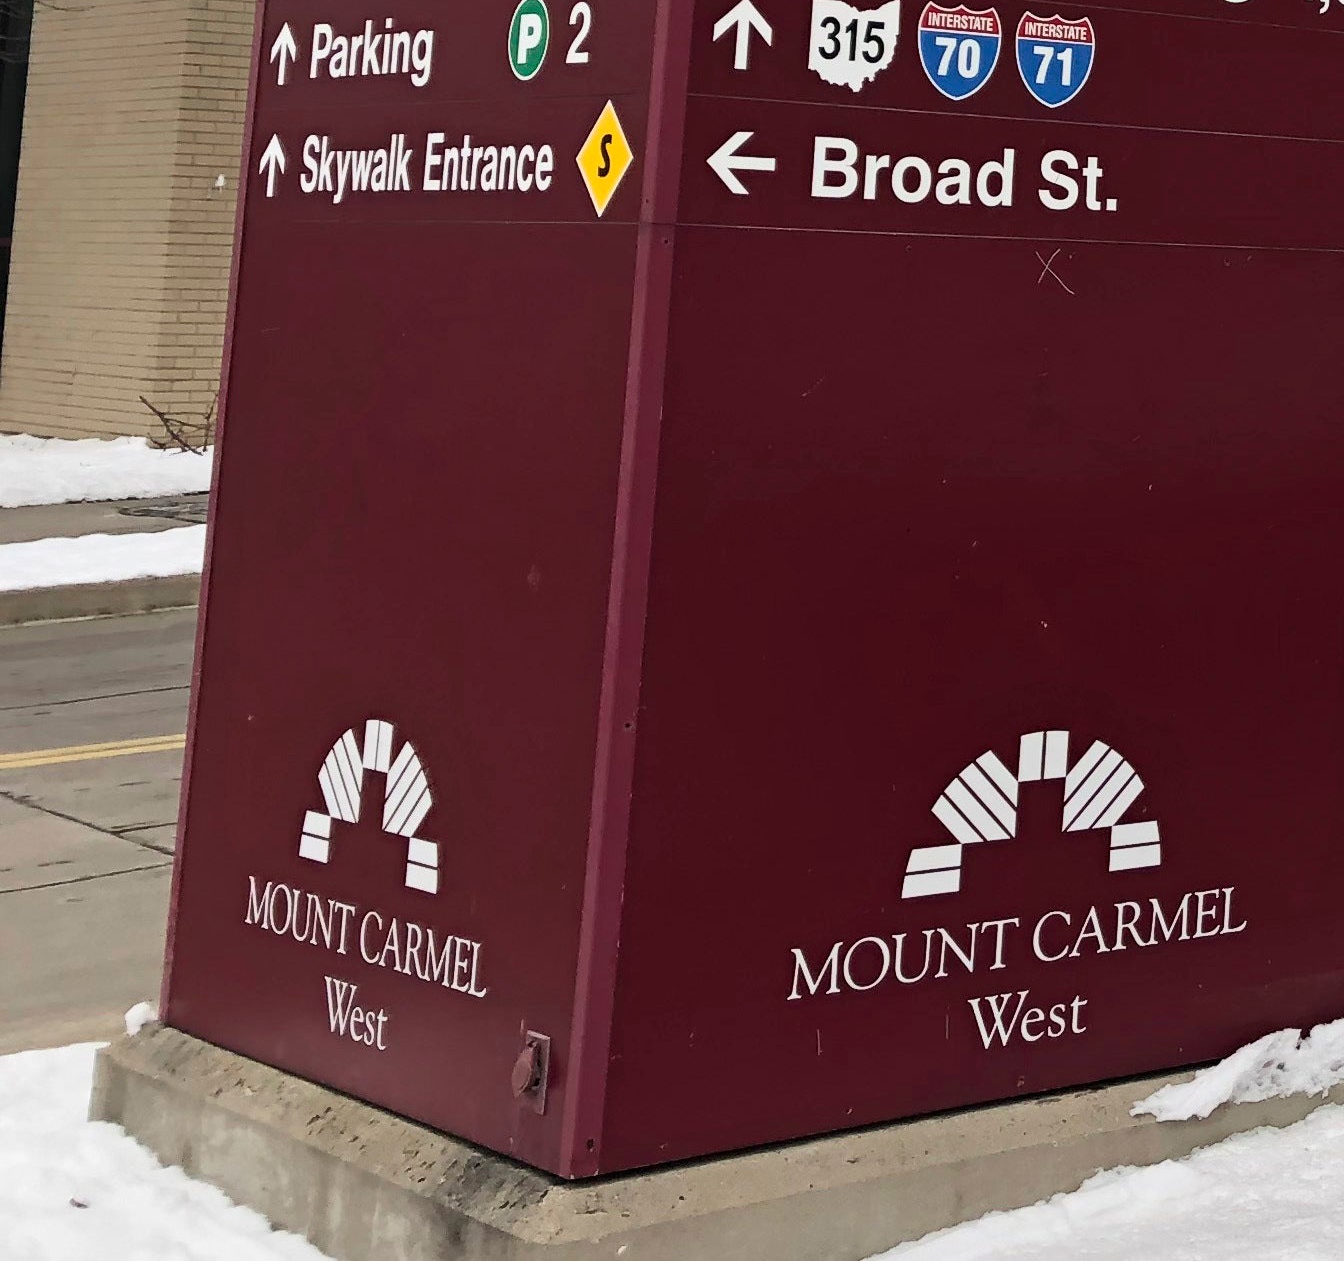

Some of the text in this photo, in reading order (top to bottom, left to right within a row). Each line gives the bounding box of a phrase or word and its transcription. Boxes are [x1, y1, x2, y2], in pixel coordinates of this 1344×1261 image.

[309, 2, 591, 87] Parking P 2
[819, 16, 885, 64] 315
[928, 11, 993, 32] INTERSTATE
[1025, 21, 1087, 40] INTERSTATE
[935, 37, 981, 78] 70
[1033, 45, 1072, 86] 71
[300, 132, 612, 204] Skywalk Entrance S
[810, 136, 1118, 212] Broad St.
[244, 875, 487, 998] MOUNT CARMEL
[787, 886, 1247, 1001] MOUNT CARMEL
[324, 975, 388, 1051] West
[967, 989, 1088, 1050] West
